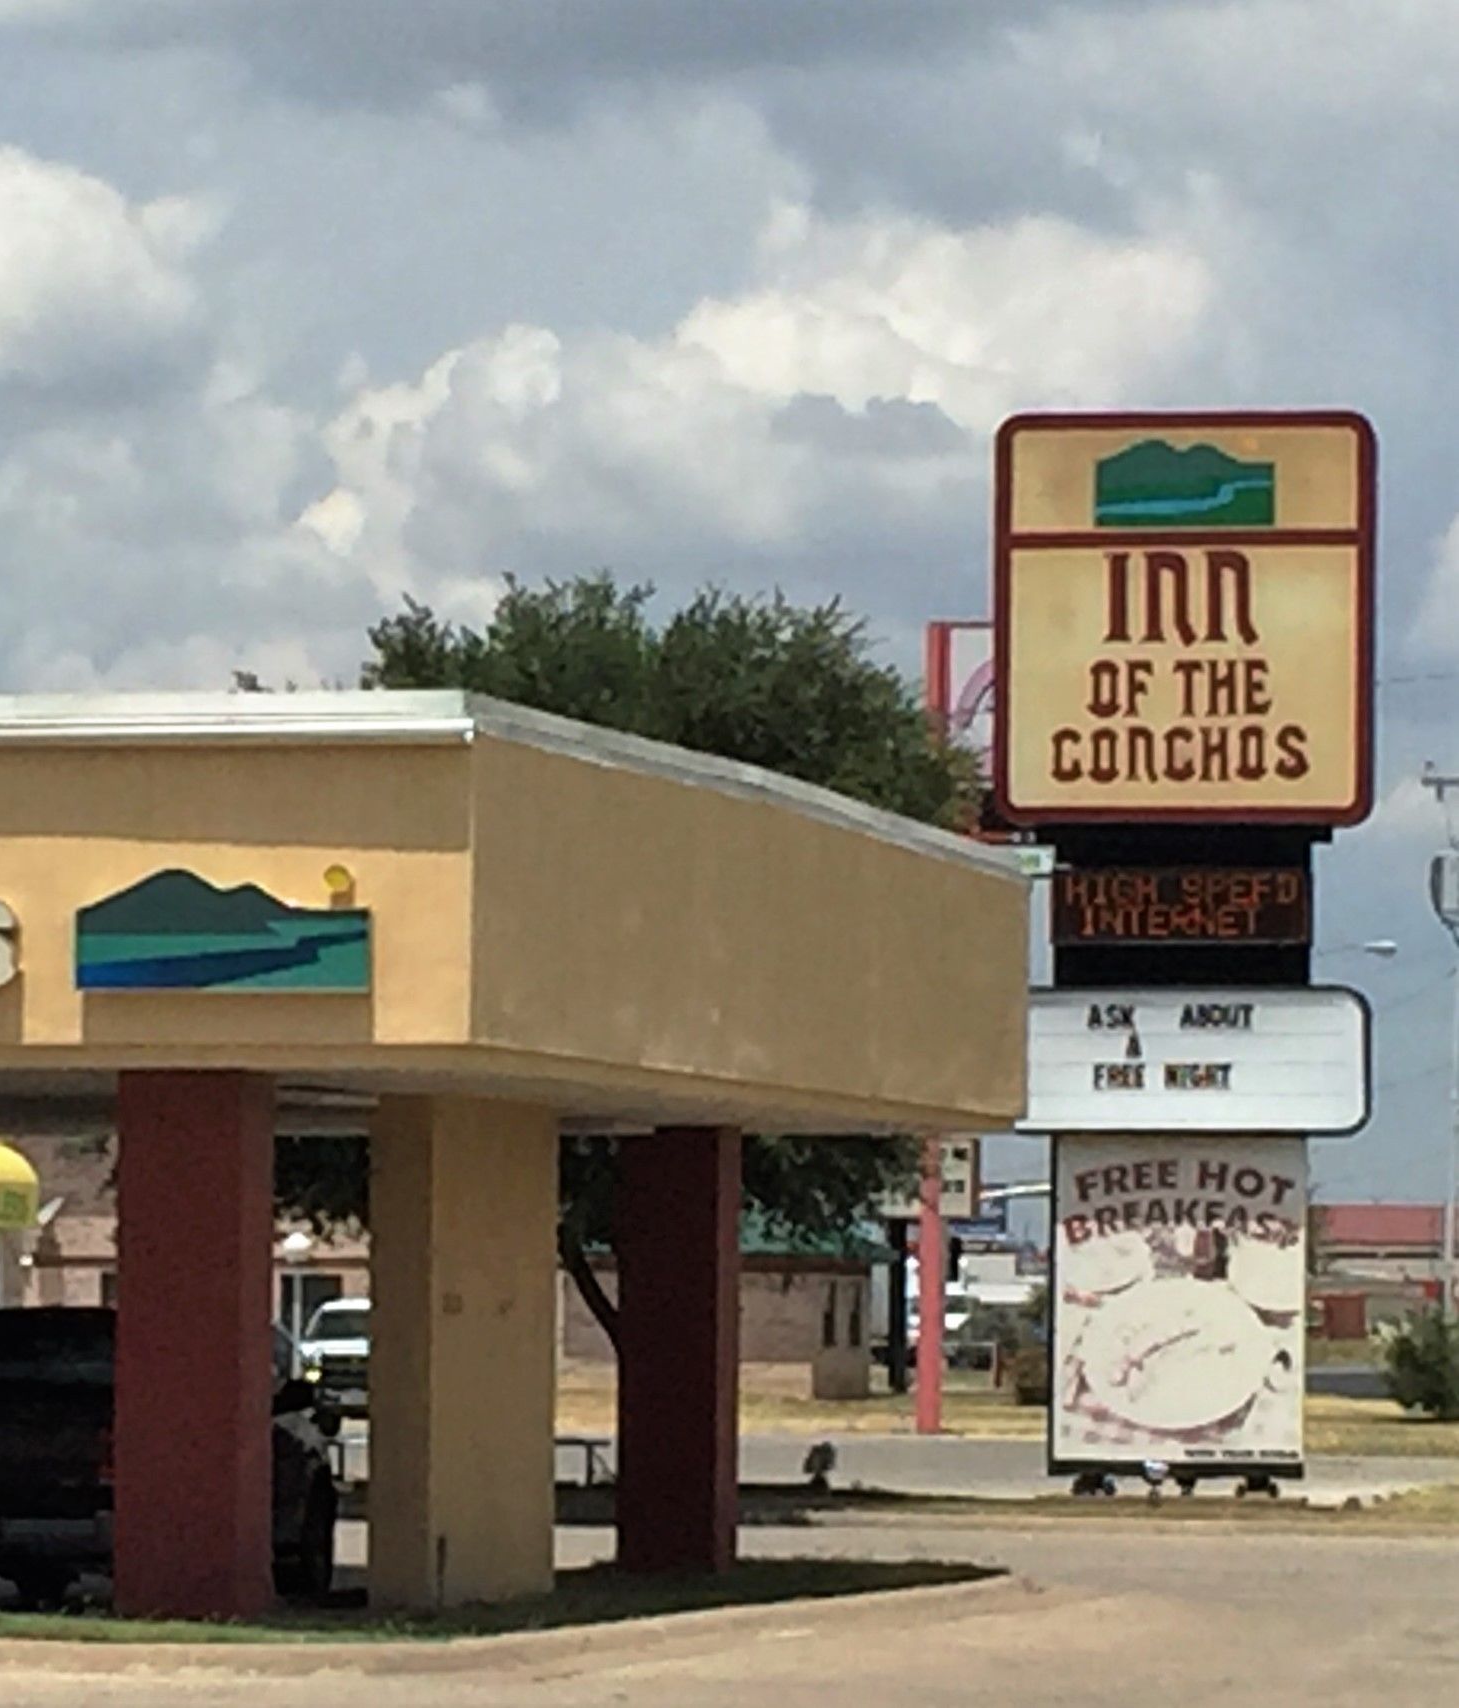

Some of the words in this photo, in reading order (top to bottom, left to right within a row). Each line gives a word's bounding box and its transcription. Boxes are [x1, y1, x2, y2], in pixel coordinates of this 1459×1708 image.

[1102, 549, 1259, 646] INN
[1086, 659, 1155, 718] OF
[1172, 657, 1273, 717] THE
[1050, 725, 1311, 784] CONCHOS
[1066, 873, 1158, 904] HIGH
[1080, 905, 1259, 937] INTERNET
[1087, 1003, 1134, 1029] ASK
[1179, 1003, 1254, 1029] ABOUT
[1125, 1031, 1142, 1058] A
[1093, 1063, 1145, 1090] FREE
[1164, 1064, 1232, 1090] NIGHT
[1074, 1159, 1179, 1201] FREE
[1197, 1161, 1296, 1204] HOT
[1062, 1198, 1300, 1246] BREAKFAST
